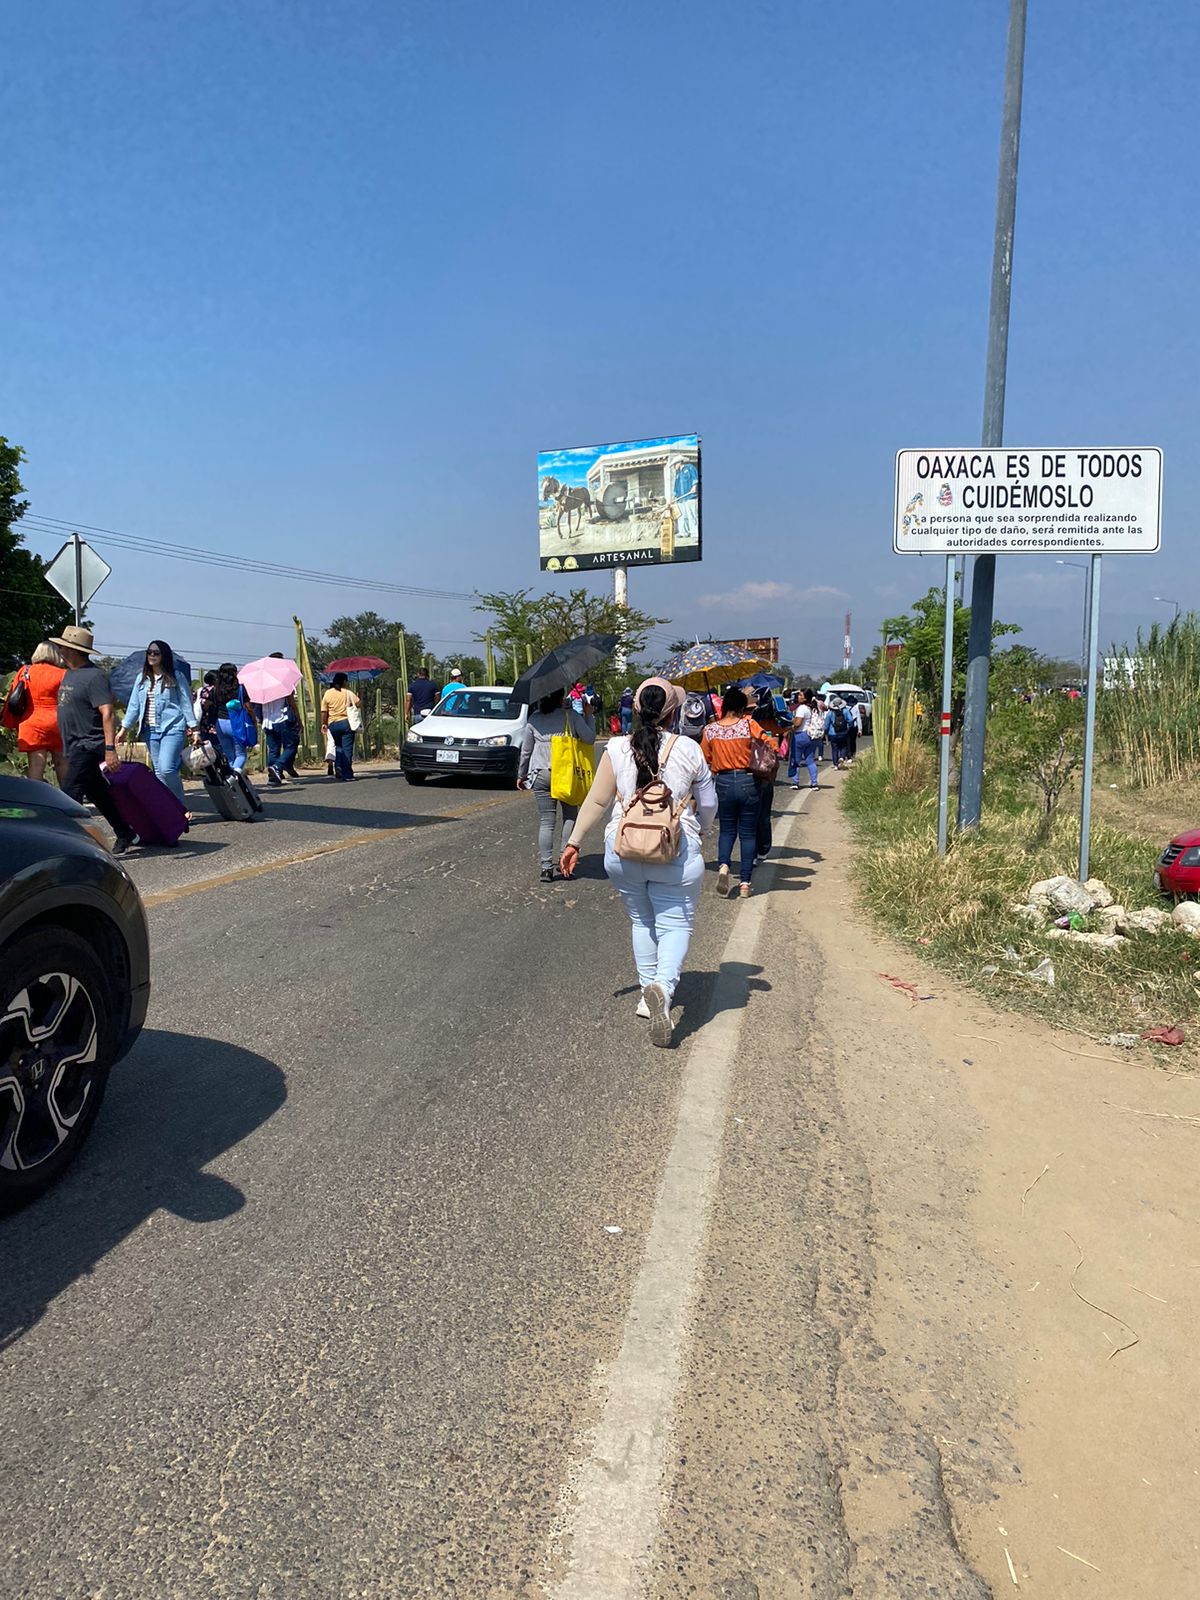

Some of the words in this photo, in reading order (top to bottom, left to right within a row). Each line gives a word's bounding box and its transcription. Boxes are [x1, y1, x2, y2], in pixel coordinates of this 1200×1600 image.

[916, 455, 996, 479] OAXACA
[1006, 454, 1030, 478] ES
[1041, 454, 1066, 478] DE
[1077, 454, 1142, 478] TODOS
[962, 479, 1094, 509] CUIDÉMOSLO
[930, 515, 972, 525] persona
[974, 515, 994, 525] que
[996, 515, 1015, 523] sea
[1017, 513, 1081, 524] sorprendida
[1083, 513, 1137, 522] realizando
[911, 526, 960, 537] cualquier
[962, 526, 982, 537] tipo
[984, 525, 998, 535] de
[1000, 525, 1029, 536] daño,
[1032, 525, 1055, 535] será
[1057, 525, 1100, 534] remitida
[1102, 526, 1125, 534] ante
[1127, 525, 1143, 534] las
[946, 537, 1008, 547] autoridades
[1010, 537, 1105, 548] correspondientes.
[592, 549, 654, 564] ARTESANAL
